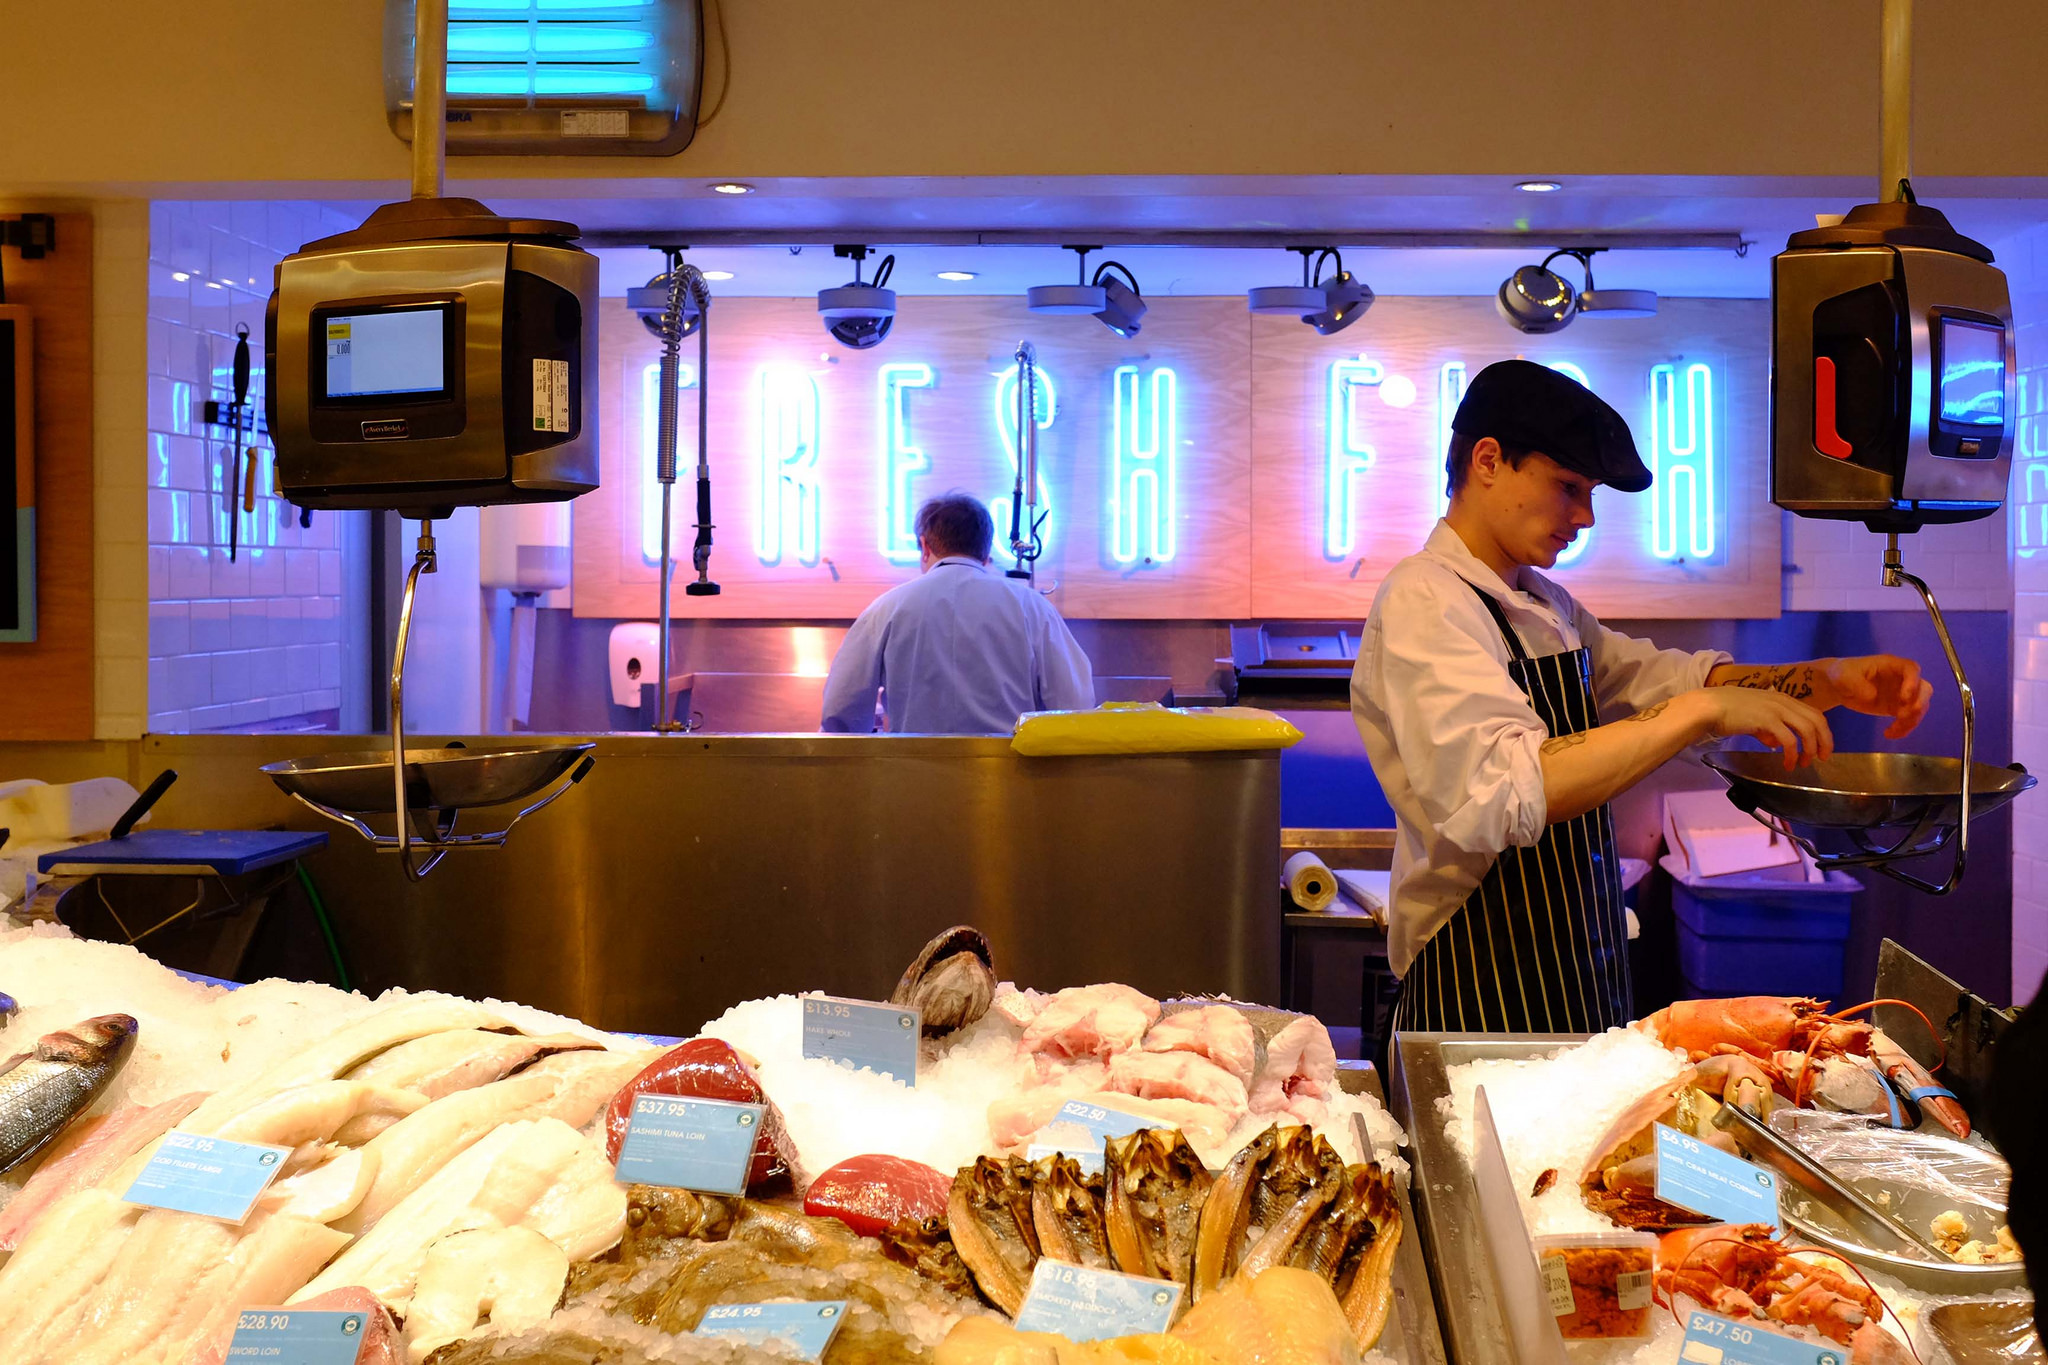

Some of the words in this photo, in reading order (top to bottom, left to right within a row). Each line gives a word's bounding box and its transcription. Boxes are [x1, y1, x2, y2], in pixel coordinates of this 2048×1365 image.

[446, 112, 472, 122] BRA
[641, 362, 1178, 563] FRESH
[1324, 358, 1716, 560] FIH
[805, 1002, 851, 1018] £13.95
[637, 1100, 686, 1117] £37.95
[1063, 1102, 1106, 1121] £22.50
[630, 1127, 662, 1136] SASHIMI
[664, 1130, 684, 1139] TUNA
[686, 1132, 706, 1141] LOIN
[1660, 1129, 1700, 1154] £6.95
[165, 1135, 215, 1153] £22.95
[153, 1156, 172, 1166] COD
[1685, 1161, 1707, 1175] CRAB
[1708, 1170, 1728, 1184] MEAT
[708, 1307, 763, 1319] £24.95
[237, 1314, 290, 1331] £28.90
[1692, 1316, 1753, 1345] £47.50
[229, 1347, 259, 1356] SWORD
[261, 1347, 281, 1356] LOIN
